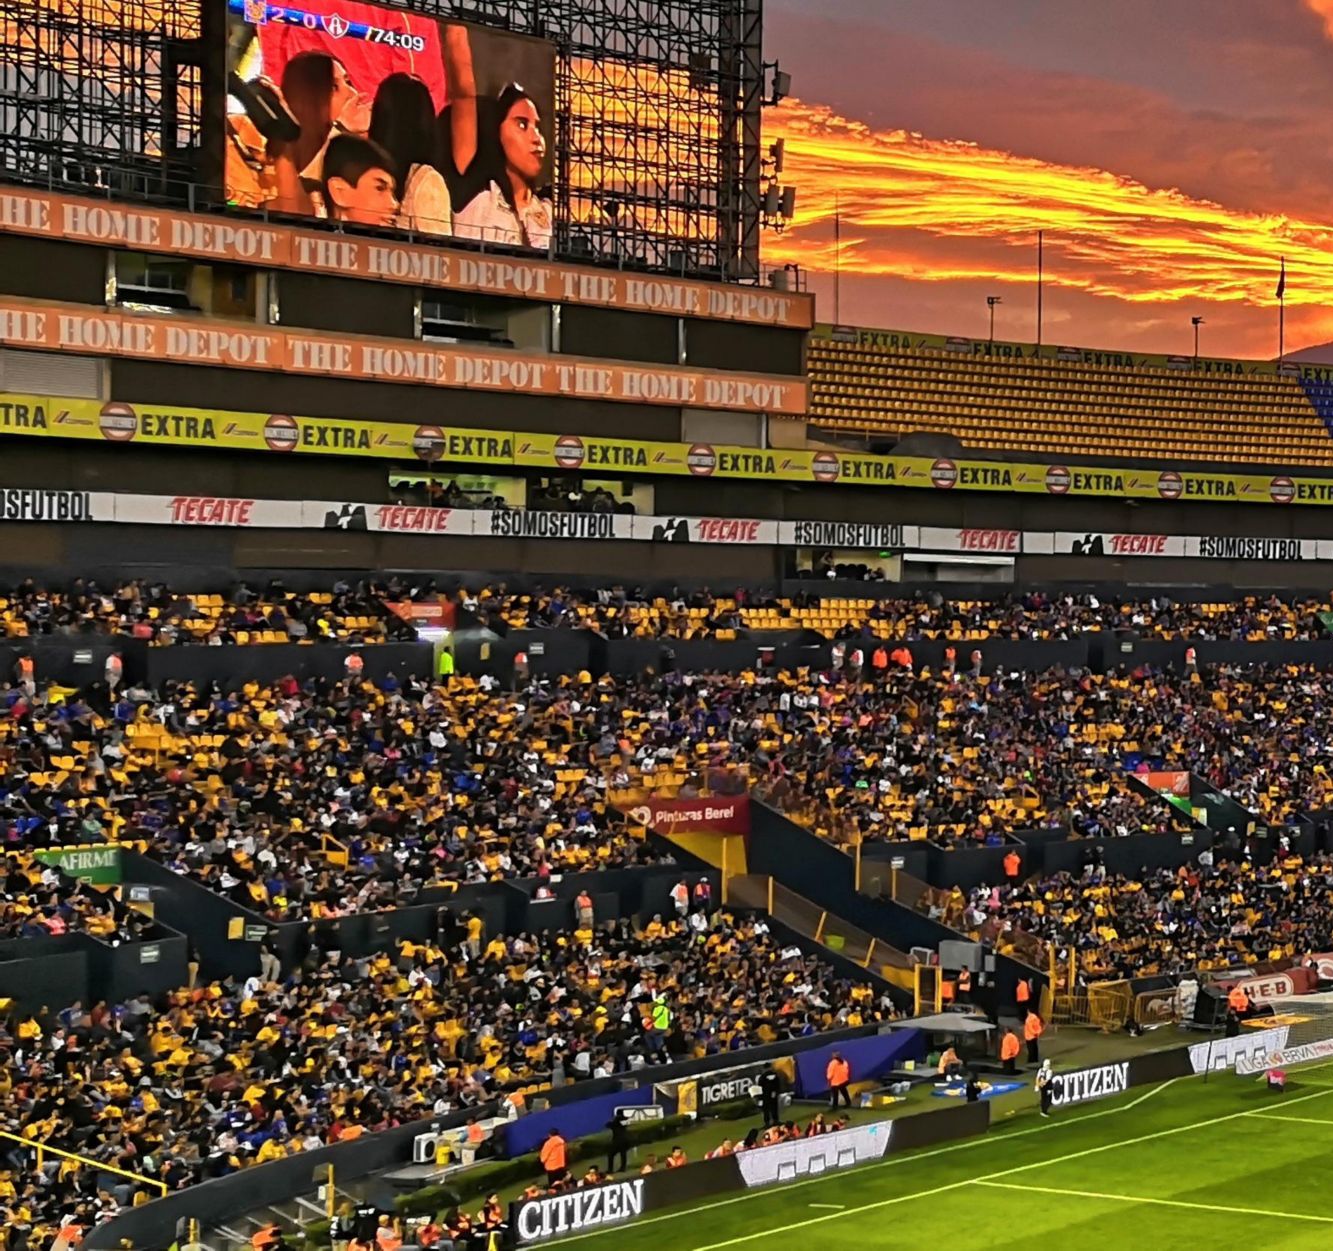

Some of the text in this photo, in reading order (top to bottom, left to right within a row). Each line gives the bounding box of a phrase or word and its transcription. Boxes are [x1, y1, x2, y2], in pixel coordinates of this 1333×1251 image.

[61, 203, 160, 246] HOME
[170, 218, 276, 259] DEPOT
[295, 236, 550, 294] THE HOME DEPOT
[560, 271, 791, 321] THE HOME DEPOT
[58, 314, 156, 353] HOME
[165, 326, 271, 364] DEPOT
[288, 340, 546, 389] THE HOME DEPOT
[556, 364, 786, 409] THE HOME DEPOT
[141, 414, 216, 440] EXTRA
[303, 424, 371, 449] EXTRA
[448, 438, 513, 460] EXTRA
[587, 446, 647, 467] EXTRA
[719, 454, 776, 475] EXTRA
[842, 461, 896, 480] EXTRA
[960, 467, 1012, 487] EXTRA
[1073, 473, 1124, 492] EXTRA
[1185, 480, 1236, 498] EXTRA
[171, 497, 254, 526] TECATE
[375, 505, 450, 531] TECATE
[490, 511, 616, 538] #SOMOSFUTBOL
[694, 520, 760, 543] TECATE
[795, 522, 905, 548] #SOMOSFUTBOL
[958, 529, 1018, 551] TECATE
[1109, 535, 1168, 555] TECATE
[1200, 539, 1302, 561] #SOMOSFUTBOL
[655, 806, 735, 824] Pinturas Berel
[1050, 1062, 1130, 1105] CITIZEN
[518, 1179, 645, 1240] CITIZEN
